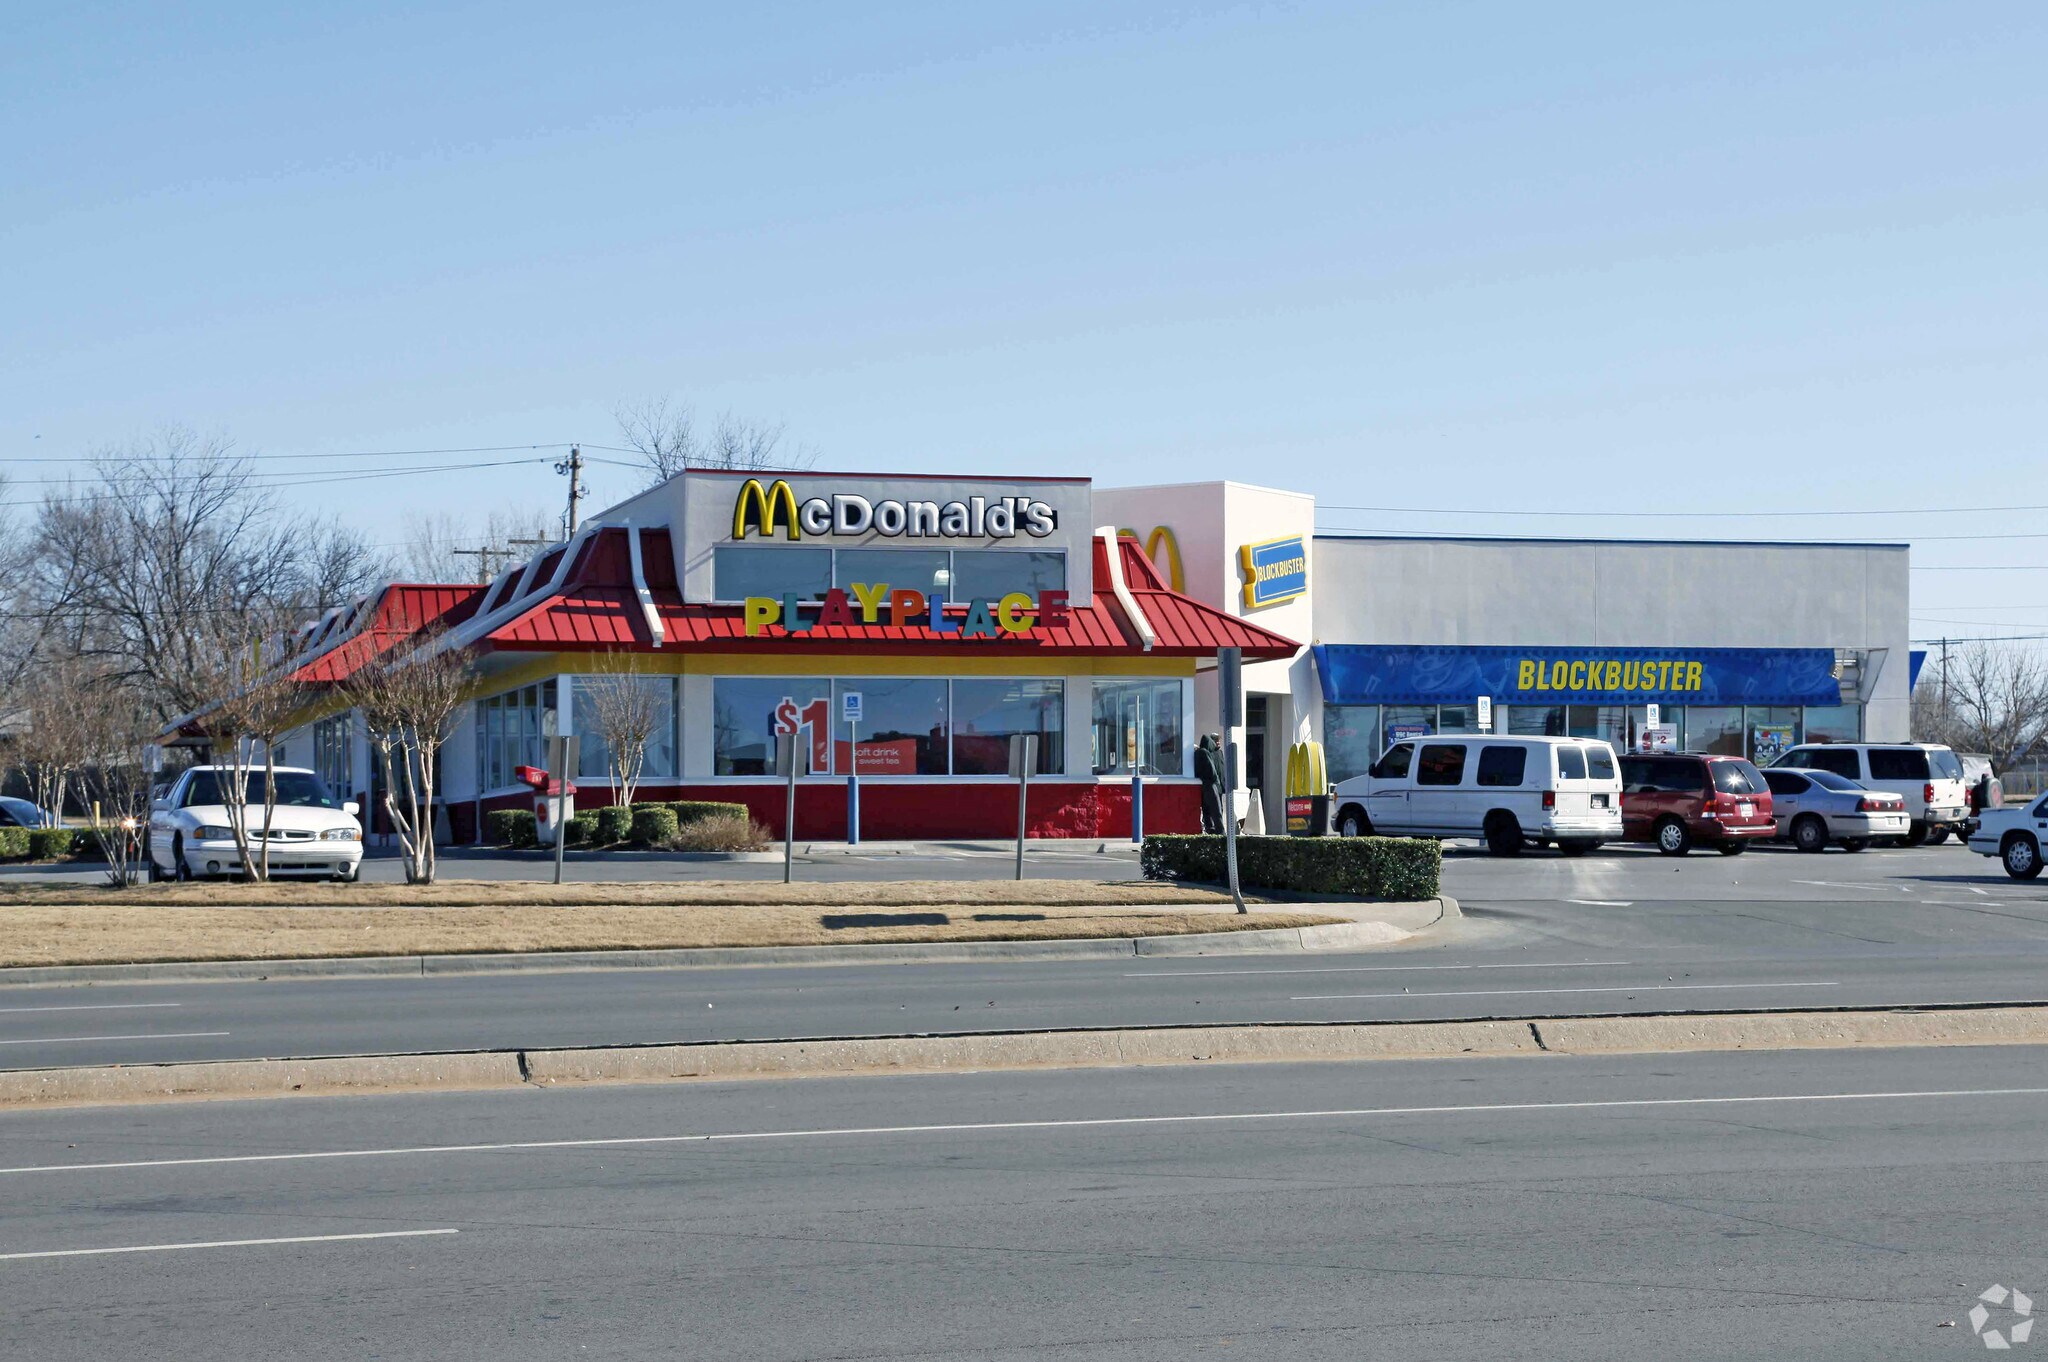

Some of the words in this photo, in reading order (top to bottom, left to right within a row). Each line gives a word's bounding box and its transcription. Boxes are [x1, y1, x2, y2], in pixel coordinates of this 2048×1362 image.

[732, 478, 1057, 541] McDonald's
[1258, 556, 1304, 582] BLOCKBUSTER
[745, 583, 1070, 637] PLAYPLACE
[1517, 660, 1703, 691] BLOCKBUSTER
[775, 697, 831, 774] $1
[858, 757, 884, 765] sweet
[872, 747, 899, 756] drink
